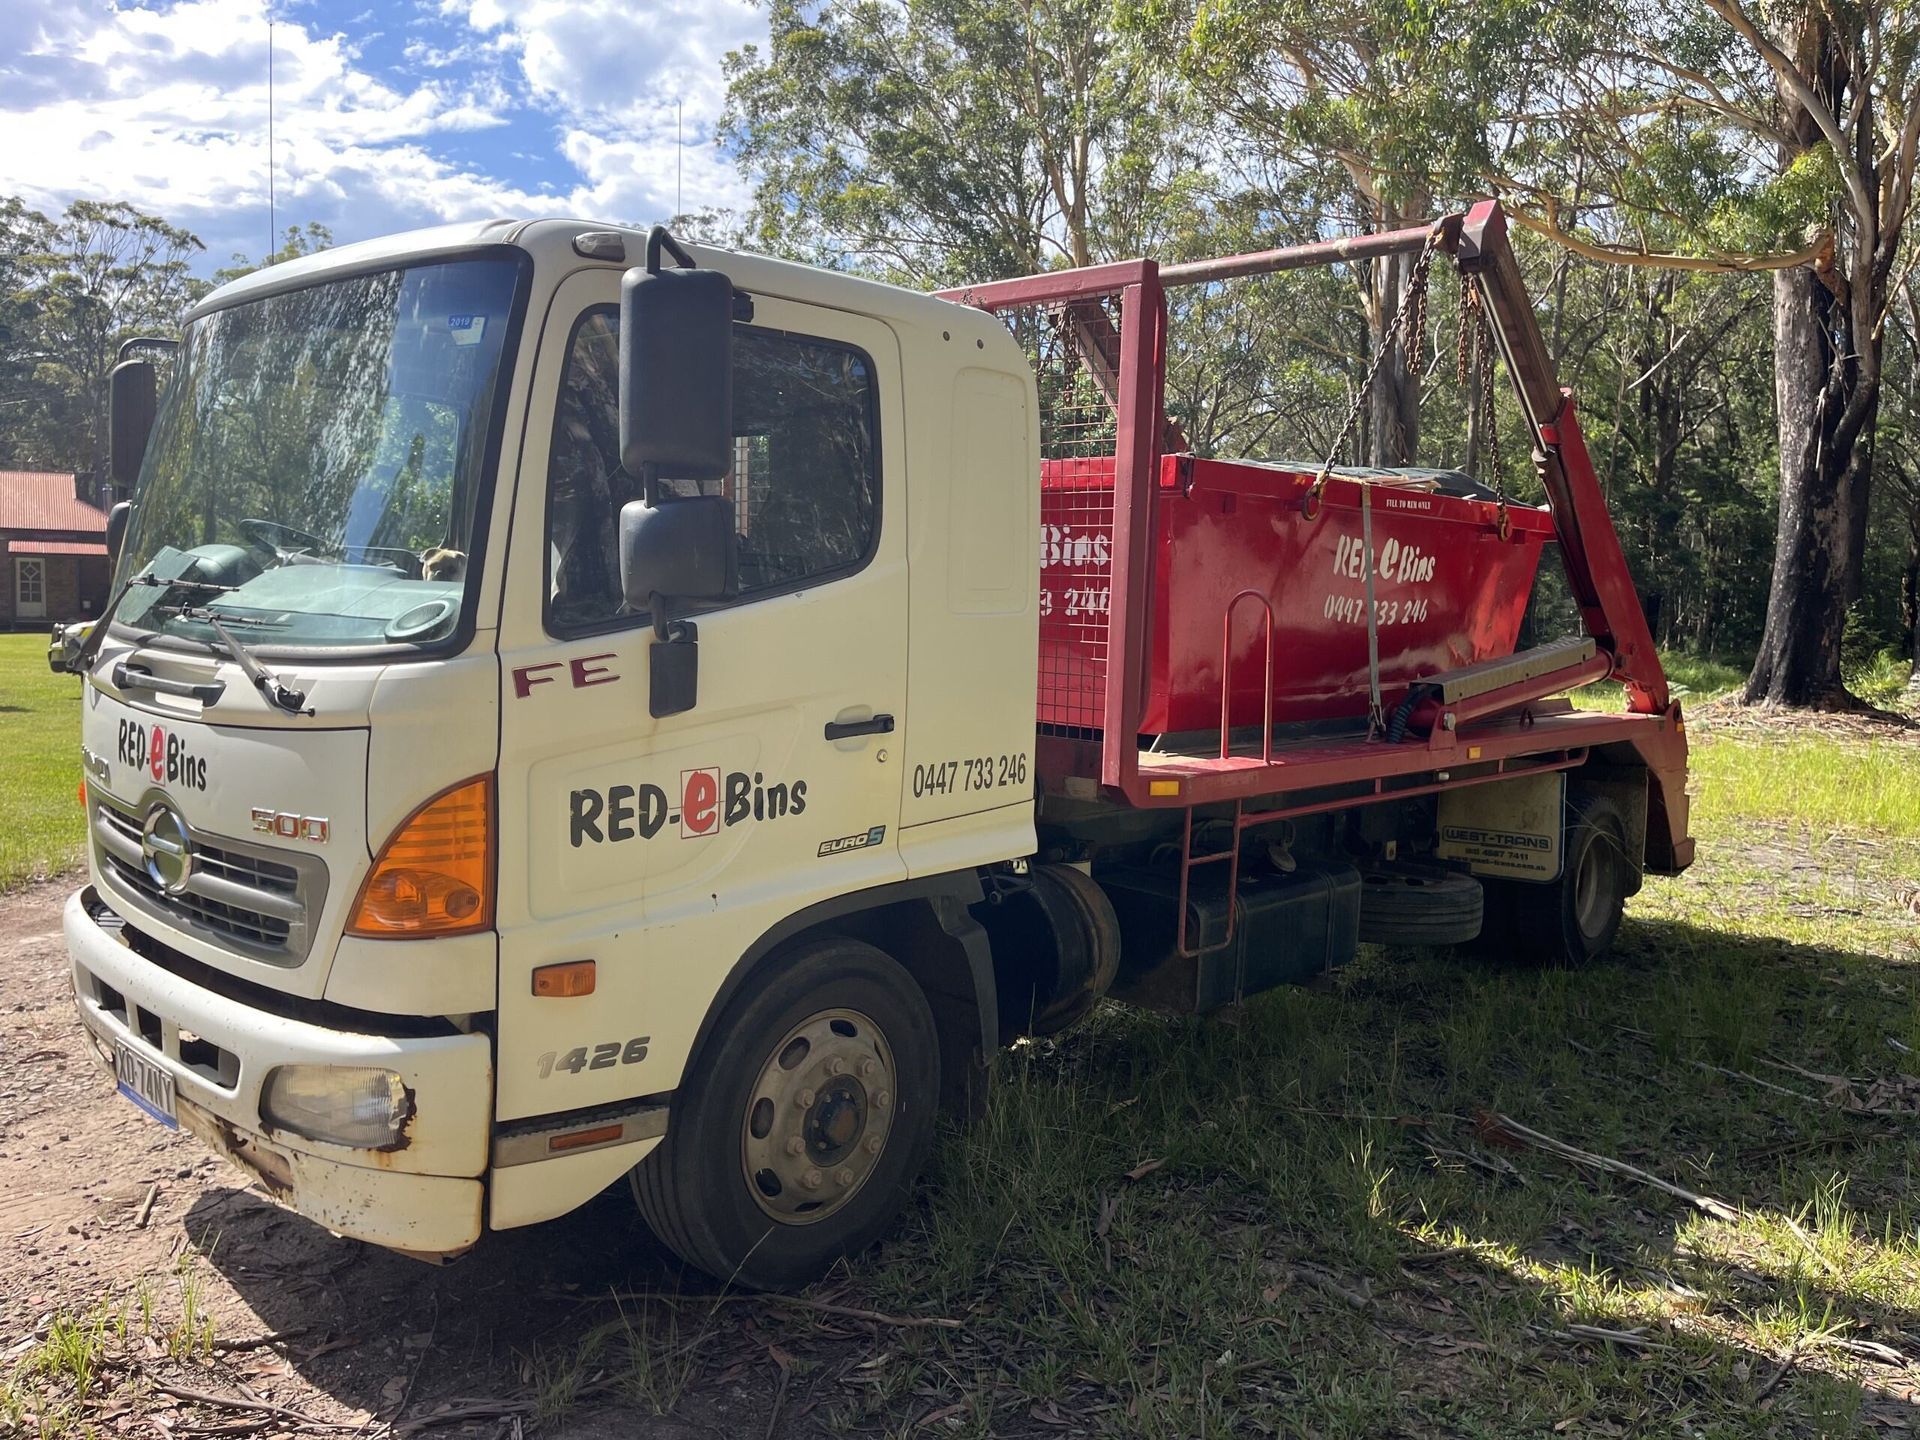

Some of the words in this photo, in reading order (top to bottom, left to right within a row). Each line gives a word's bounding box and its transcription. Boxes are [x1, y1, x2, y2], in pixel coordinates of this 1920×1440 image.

[1040, 523, 1109, 569] Bins
[1324, 594, 1363, 624] 0447
[1373, 600, 1399, 626] 33
[1401, 598, 1428, 624] 246
[511, 652, 621, 699] FE
[912, 761, 958, 798] 0447
[963, 756, 994, 792] 733
[997, 752, 1027, 787] 246
[251, 806, 329, 844] 500
[1445, 828, 1550, 849] WEST-TRANS
[537, 1036, 651, 1079] 1426
